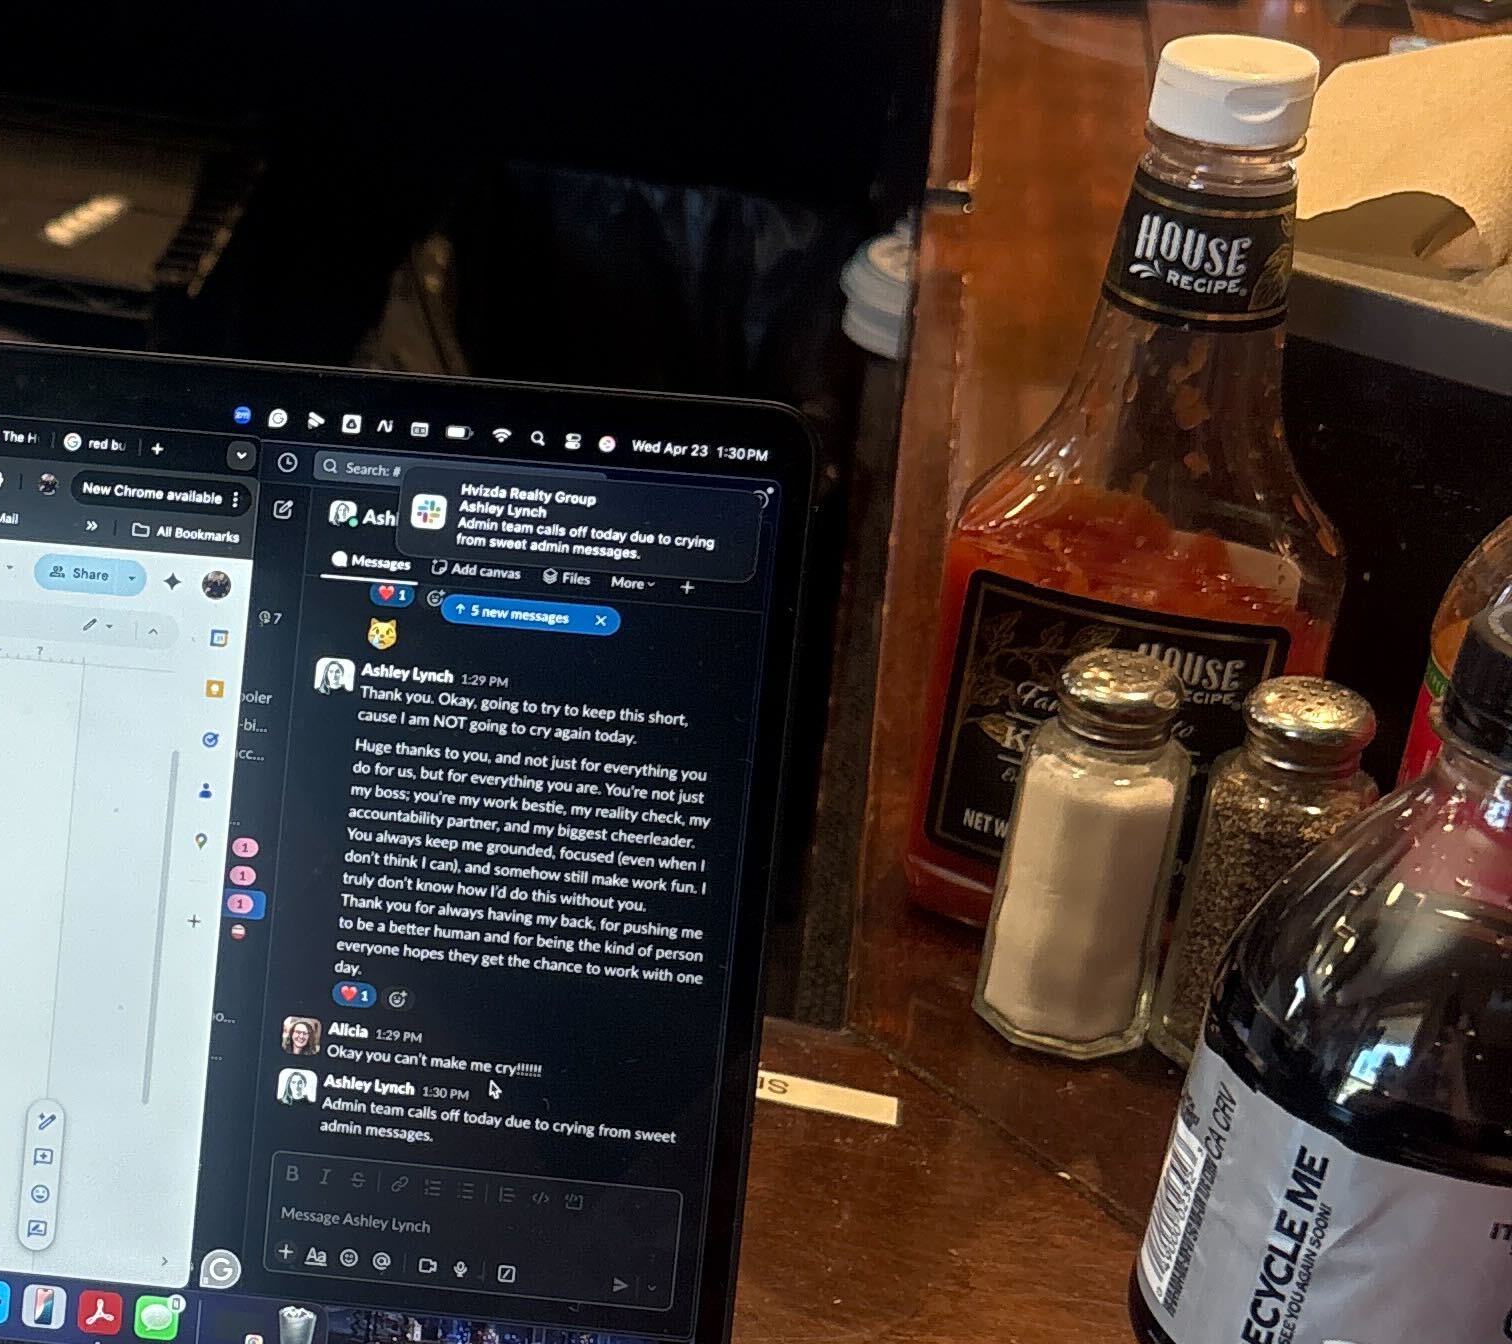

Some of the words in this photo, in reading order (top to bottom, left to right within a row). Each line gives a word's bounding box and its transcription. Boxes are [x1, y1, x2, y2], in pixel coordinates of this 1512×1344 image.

[1135, 214, 1252, 276] HOUSE
[632, 439, 662, 454] Wed
[663, 442, 688, 457] Apr
[690, 444, 709, 457] 23
[459, 499, 505, 517] Ashley
[507, 503, 547, 519] Lynch
[461, 483, 507, 499] Hvizda
[509, 487, 553, 504] Realty
[554, 490, 597, 508] Group
[156, 526, 173, 537] All
[174, 527, 240, 544] Bookmarks
[456, 532, 487, 547] from
[488, 537, 528, 550] sweet
[529, 539, 570, 554] admin
[572, 544, 641, 560] messages.
[457, 516, 499, 531] Admin
[501, 520, 534, 534] team
[536, 523, 566, 537] calls
[568, 525, 589, 538] off
[590, 528, 628, 544] today
[629, 530, 655, 544] due
[657, 533, 672, 546] to
[674, 535, 715, 551] crying
[72, 567, 110, 582] Share
[361, 662, 411, 682] Ashley
[412, 666, 454, 684] Lynch
[462, 673, 487, 686] 1:29
[488, 675, 509, 688] PM
[360, 685, 403, 702] Thank
[405, 692, 434, 705] you.
[438, 692, 478, 710] Okay,
[480, 697, 520, 715] going
[522, 700, 538, 714] to
[540, 701, 562, 718] try
[564, 703, 580, 717] to
[582, 703, 616, 722] keep
[619, 708, 645, 723] this
[648, 710, 689, 728] short,
[1285, 1145, 1329, 1212] ME
[1287, 1293, 1304, 1322] YOU
[1296, 1253, 1316, 1294] AGAIN
[1310, 1204, 1332, 1251] SOON!
